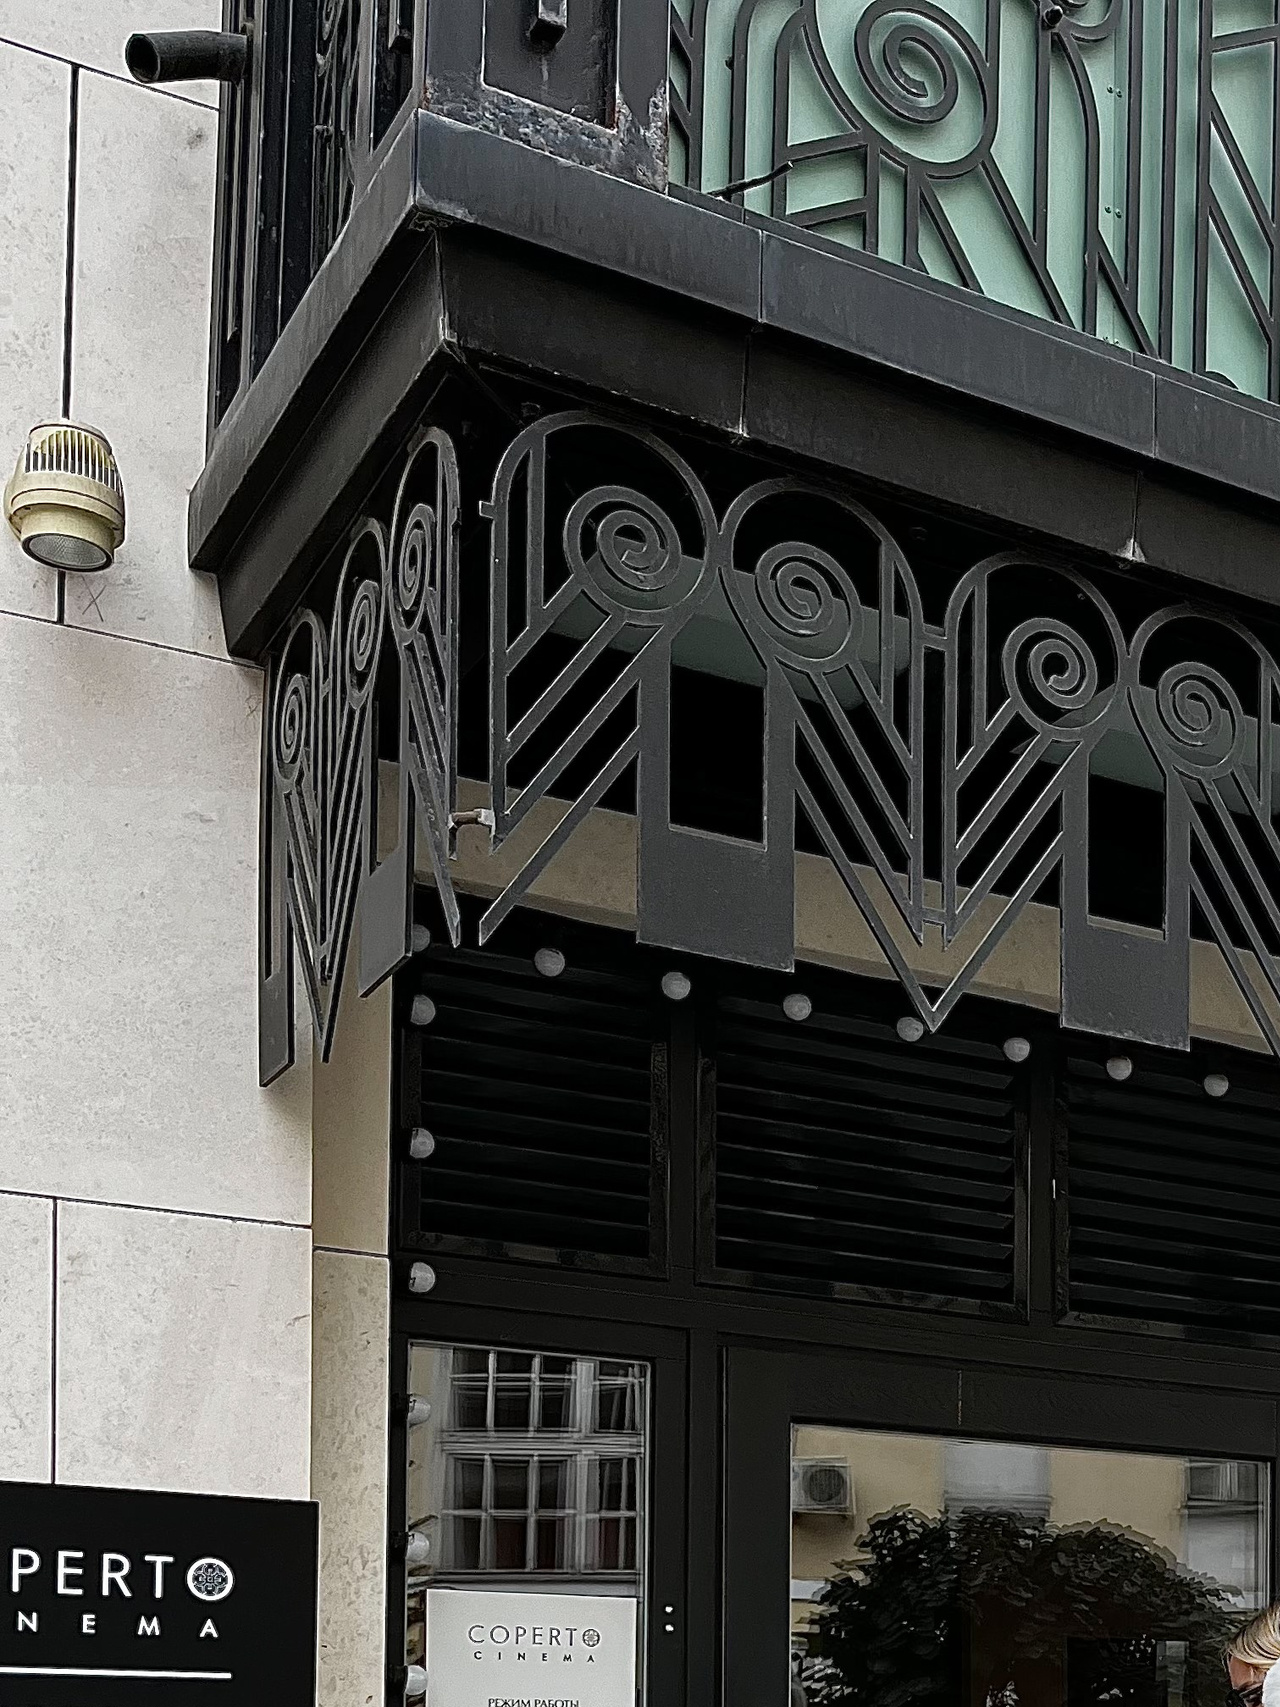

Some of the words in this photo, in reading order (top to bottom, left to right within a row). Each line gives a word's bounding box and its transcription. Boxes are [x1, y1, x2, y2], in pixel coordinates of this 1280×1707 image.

[17, 1611, 219, 1638] NEMA
[468, 1625, 601, 1648] COPERTO
[473, 1650, 595, 1663] CINEMA
